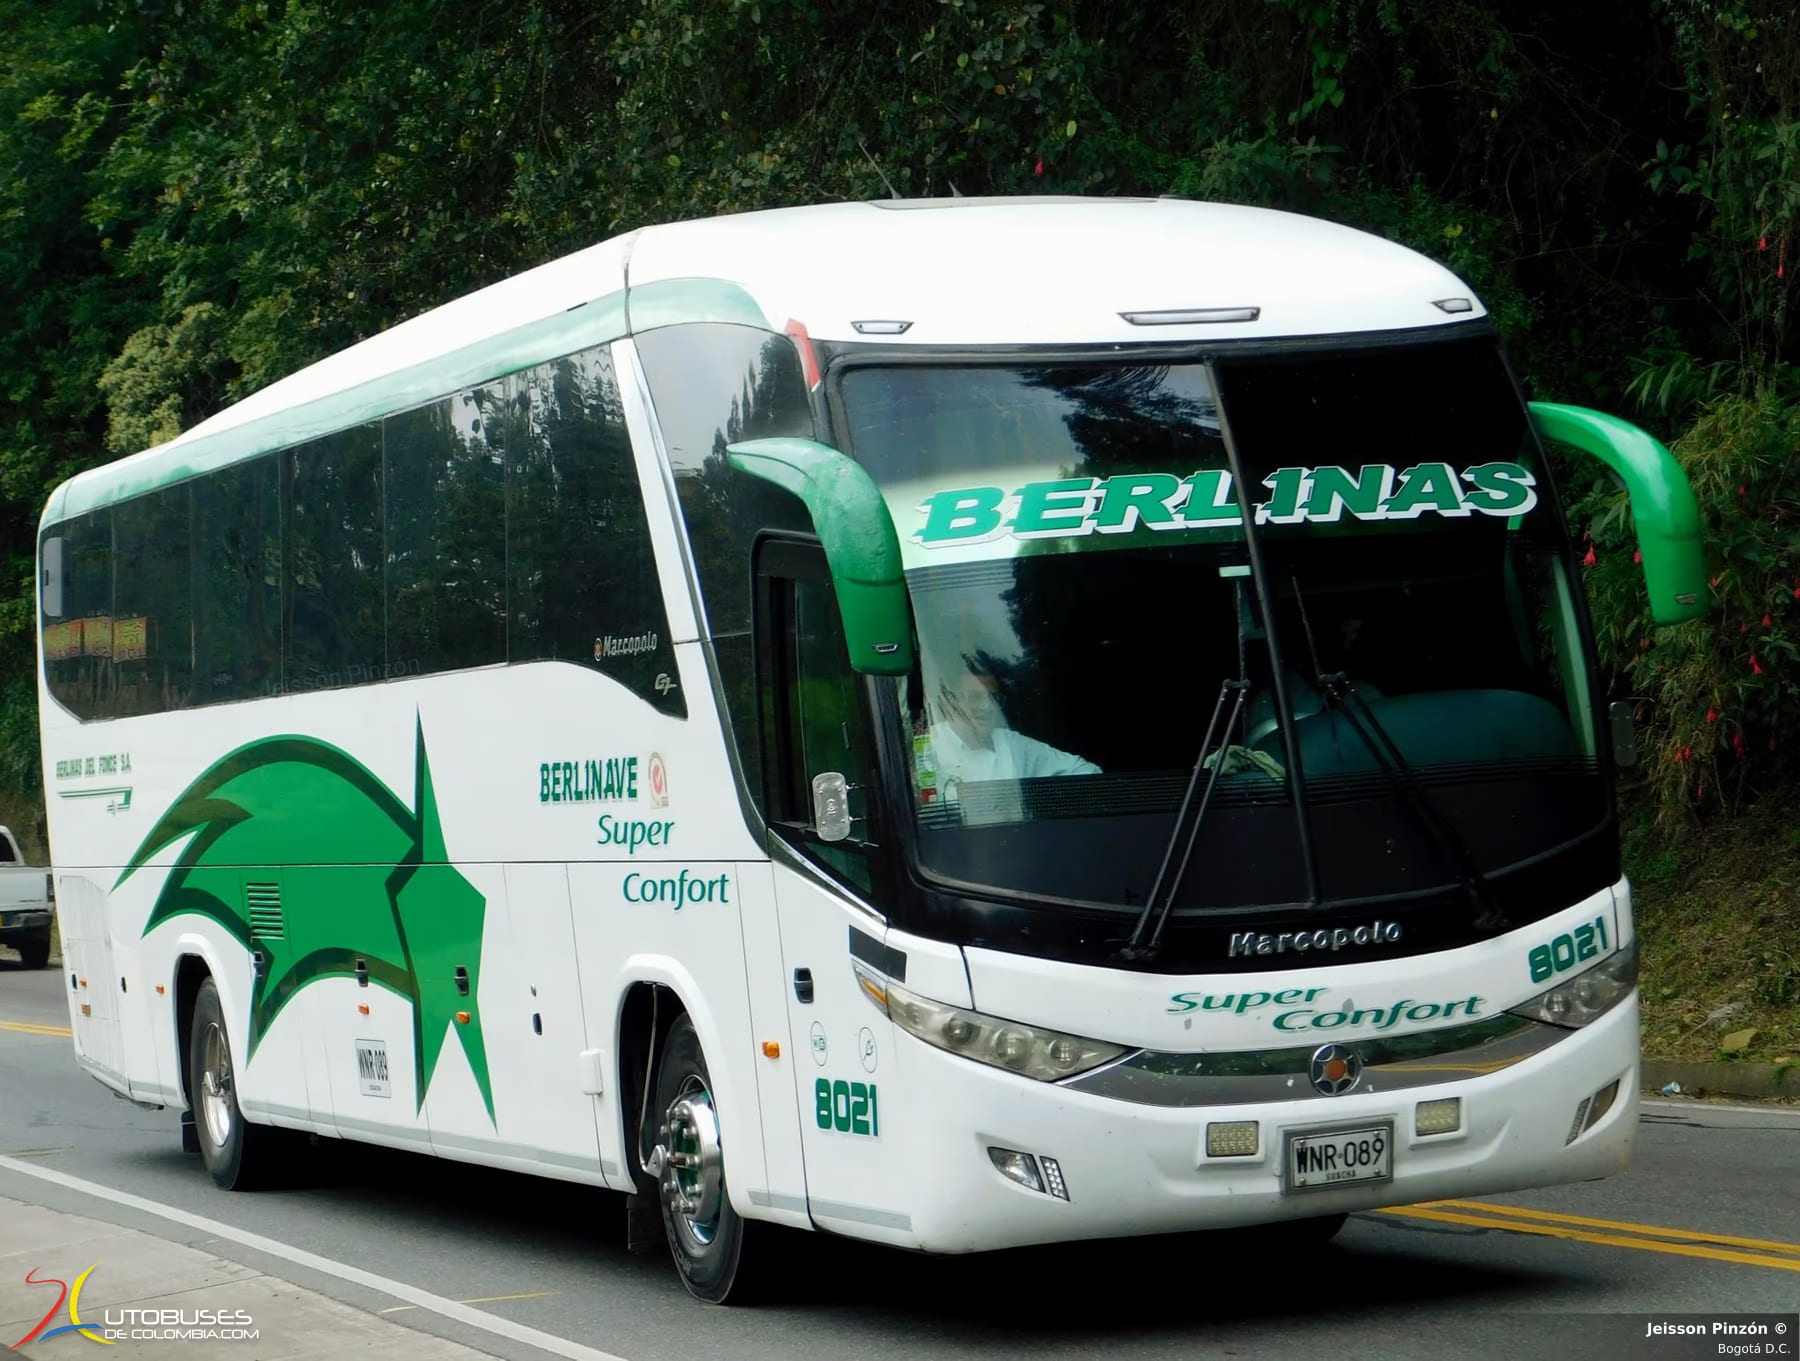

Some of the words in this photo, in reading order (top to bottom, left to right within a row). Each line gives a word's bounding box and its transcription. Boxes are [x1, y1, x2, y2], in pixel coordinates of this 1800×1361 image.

[907, 461, 1537, 550] BERLINAS
[603, 631, 658, 657] Marcopolo
[540, 756, 638, 803] BERLINAVE
[597, 814, 674, 855] Super
[622, 869, 729, 911] Confort
[1228, 920, 1404, 958] Marcopolo
[1528, 916, 1609, 984] 8021
[1166, 986, 1329, 1015] Super
[1272, 994, 1486, 1032] Confort
[815, 1077, 880, 1137] 8021
